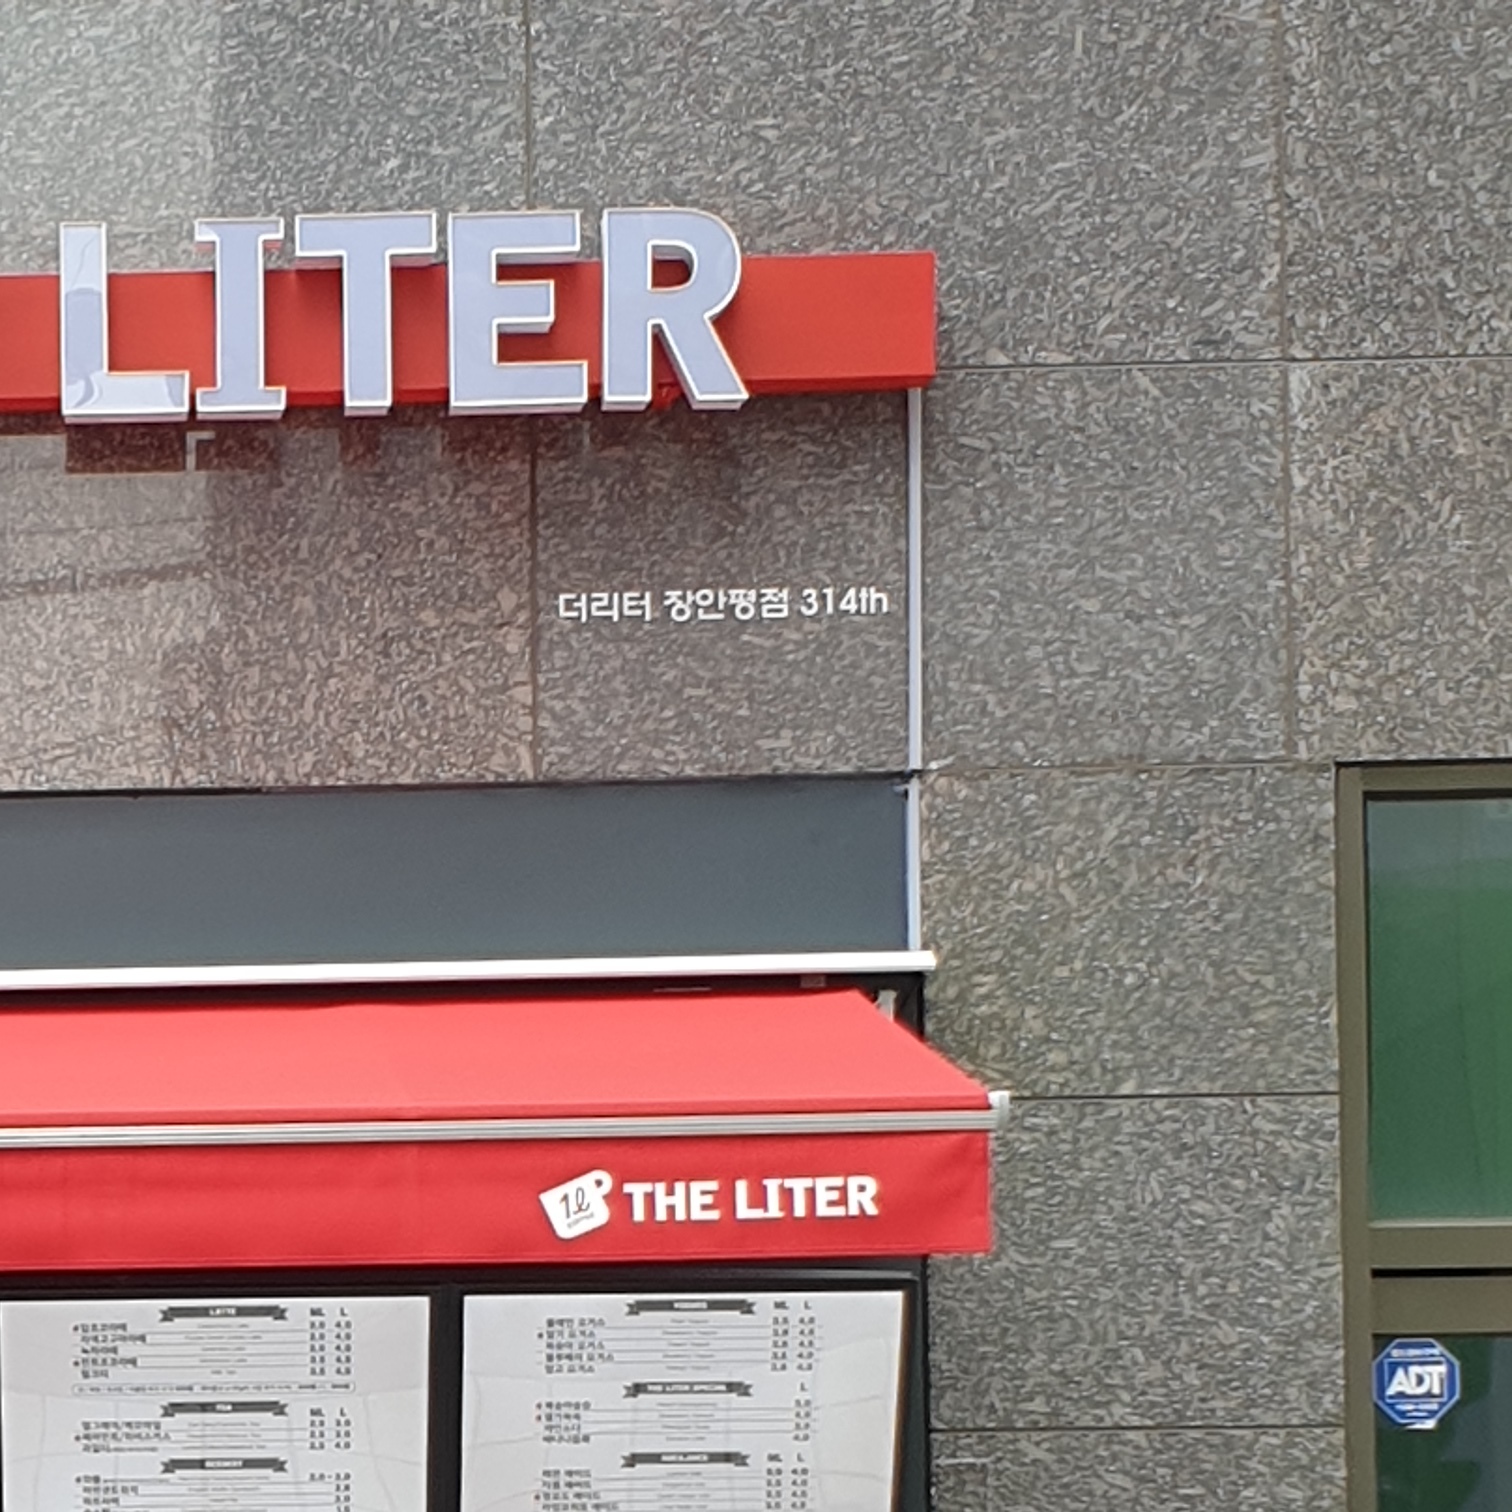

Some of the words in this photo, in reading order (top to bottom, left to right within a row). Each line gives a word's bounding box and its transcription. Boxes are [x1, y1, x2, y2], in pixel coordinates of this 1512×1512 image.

[58, 207, 750, 423] LITER
[557, 591, 652, 623] 더리터
[663, 587, 790, 623] 장안평점
[800, 586, 889, 617] 314th
[623, 1180, 721, 1223] THE
[735, 1175, 879, 1219] LITER
[1385, 1364, 1447, 1396] ADT
